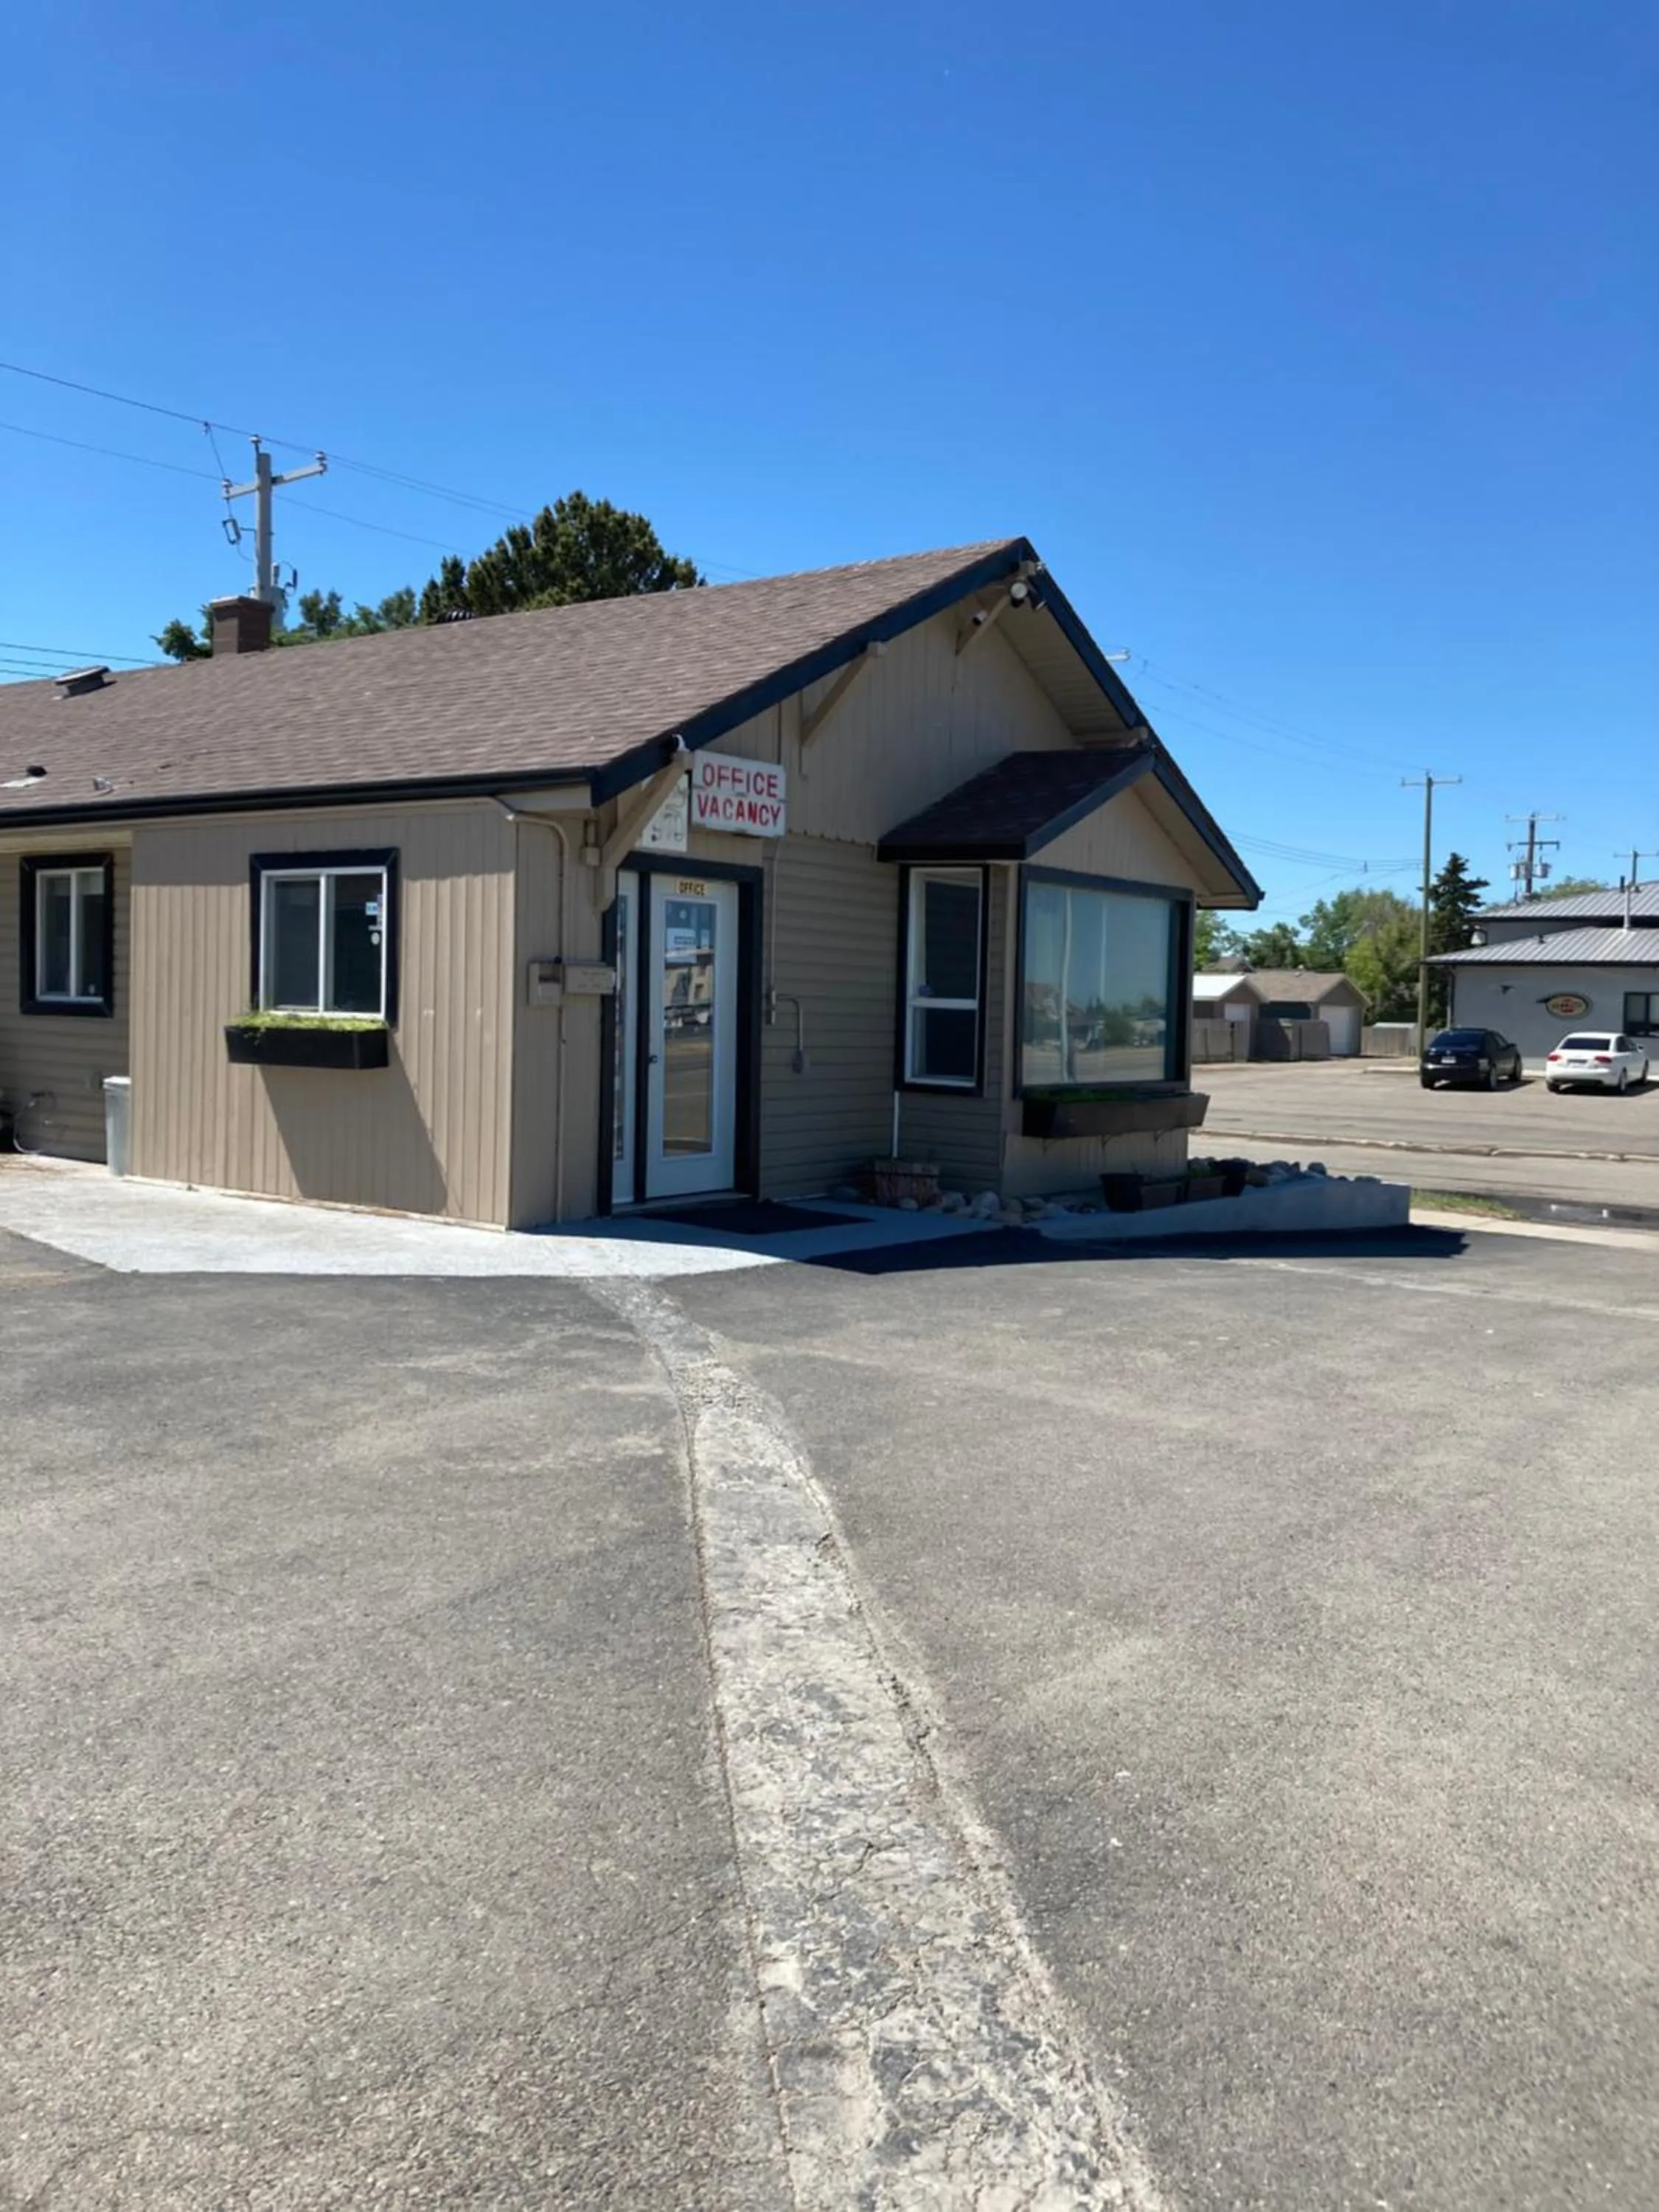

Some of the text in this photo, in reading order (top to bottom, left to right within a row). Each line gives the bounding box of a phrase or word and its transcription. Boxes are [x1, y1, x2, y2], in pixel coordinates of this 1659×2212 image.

[703, 762, 778, 799] OFFICE
[697, 793, 782, 827] VACANCY
[679, 881, 706, 896] OFFICE
